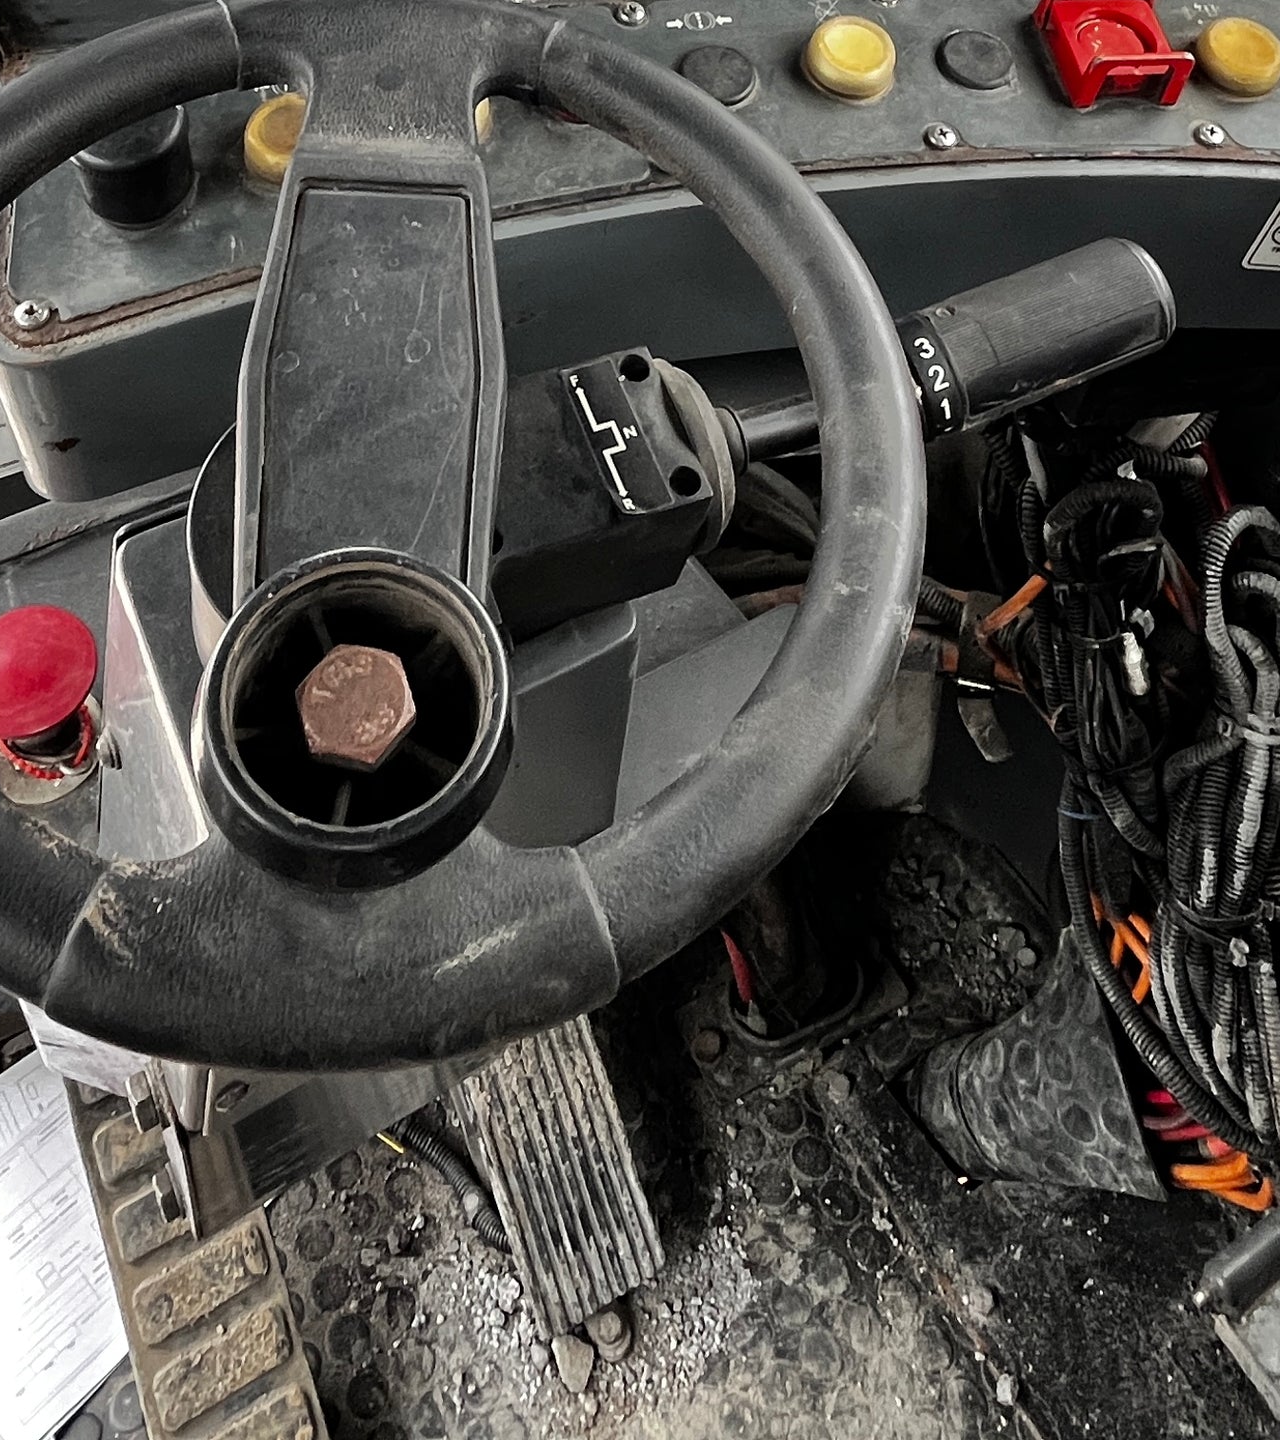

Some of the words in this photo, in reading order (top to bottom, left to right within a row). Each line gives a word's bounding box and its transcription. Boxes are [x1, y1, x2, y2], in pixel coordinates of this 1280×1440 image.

[913, 336, 935, 359] 3
[568, 375, 581, 388] F
[927, 364, 951, 392] 2
[939, 397, 952, 420] 1
[622, 424, 638, 440] N
[621, 497, 636, 511] R
